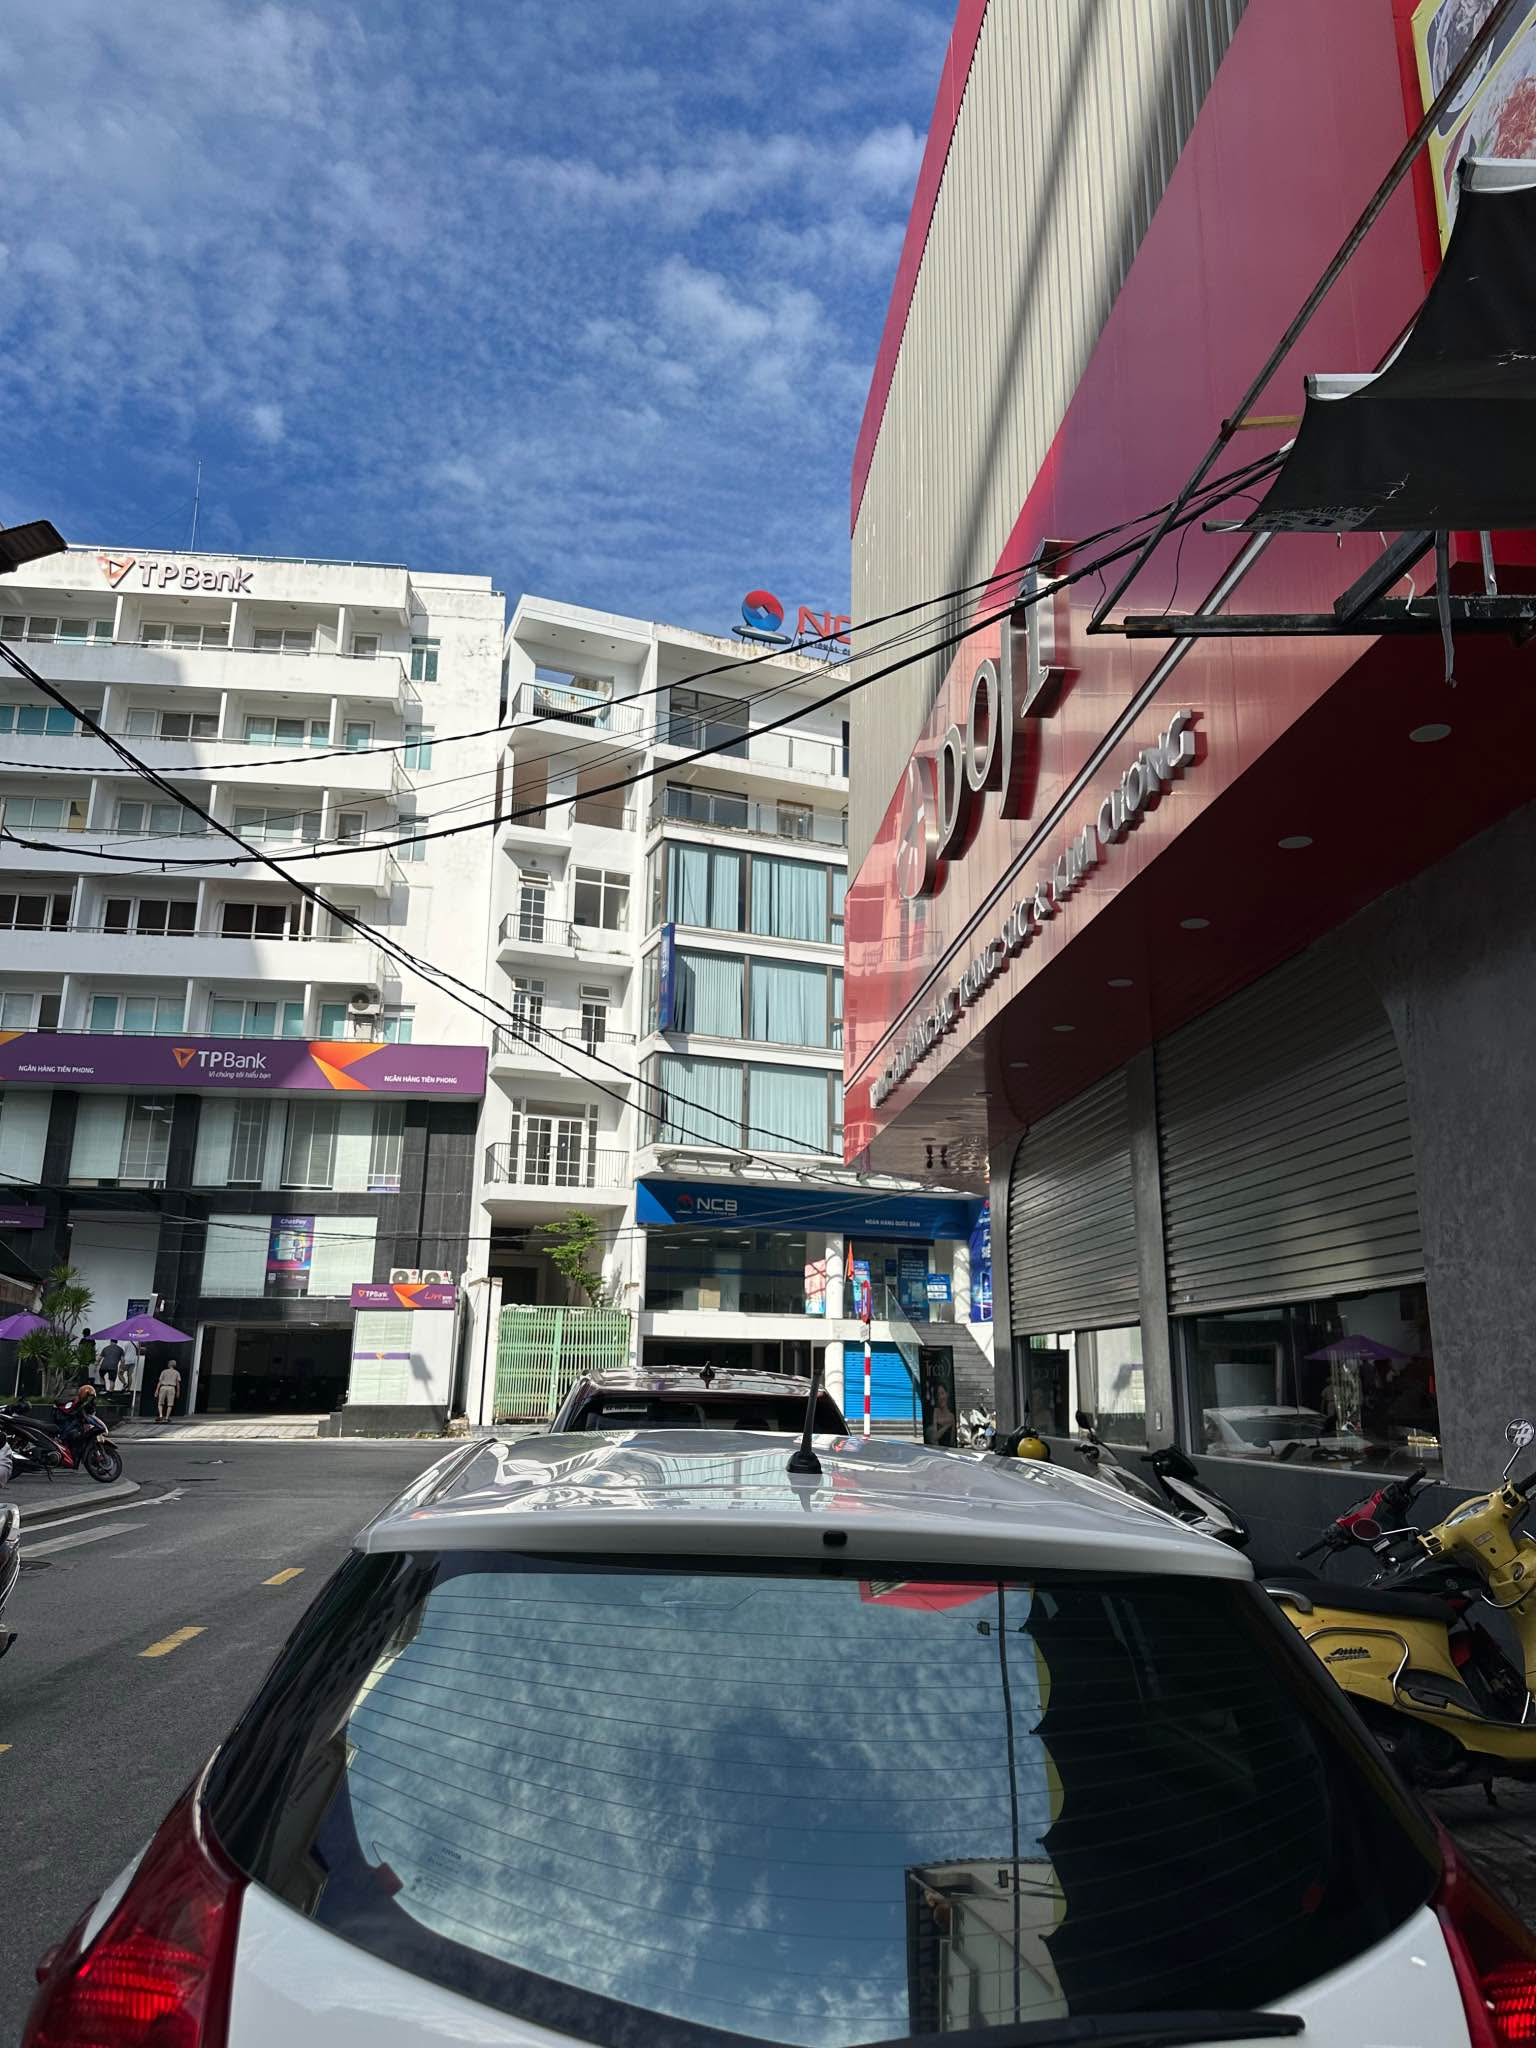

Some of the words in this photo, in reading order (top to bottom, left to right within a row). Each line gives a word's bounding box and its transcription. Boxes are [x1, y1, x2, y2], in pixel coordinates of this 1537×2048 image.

[138, 560, 254, 594] TPBank
[798, 604, 851, 646] NC
[936, 537, 1061, 860] DOJI
[959, 937, 1003, 1007] TRANG
[1033, 881, 1054, 921] &
[1053, 823, 1098, 902] KIM
[1097, 708, 1195, 844] CƯƠNG
[18, 1064, 37, 1072] NGÂN
[37, 1065, 56, 1073] HÀNG
[71, 1066, 95, 1074] PHONG
[198, 1050, 267, 1069] TPBank
[435, 1076, 458, 1084] PHONG
[697, 1197, 738, 1212] NCB
[366, 1290, 388, 1298] TPBank
